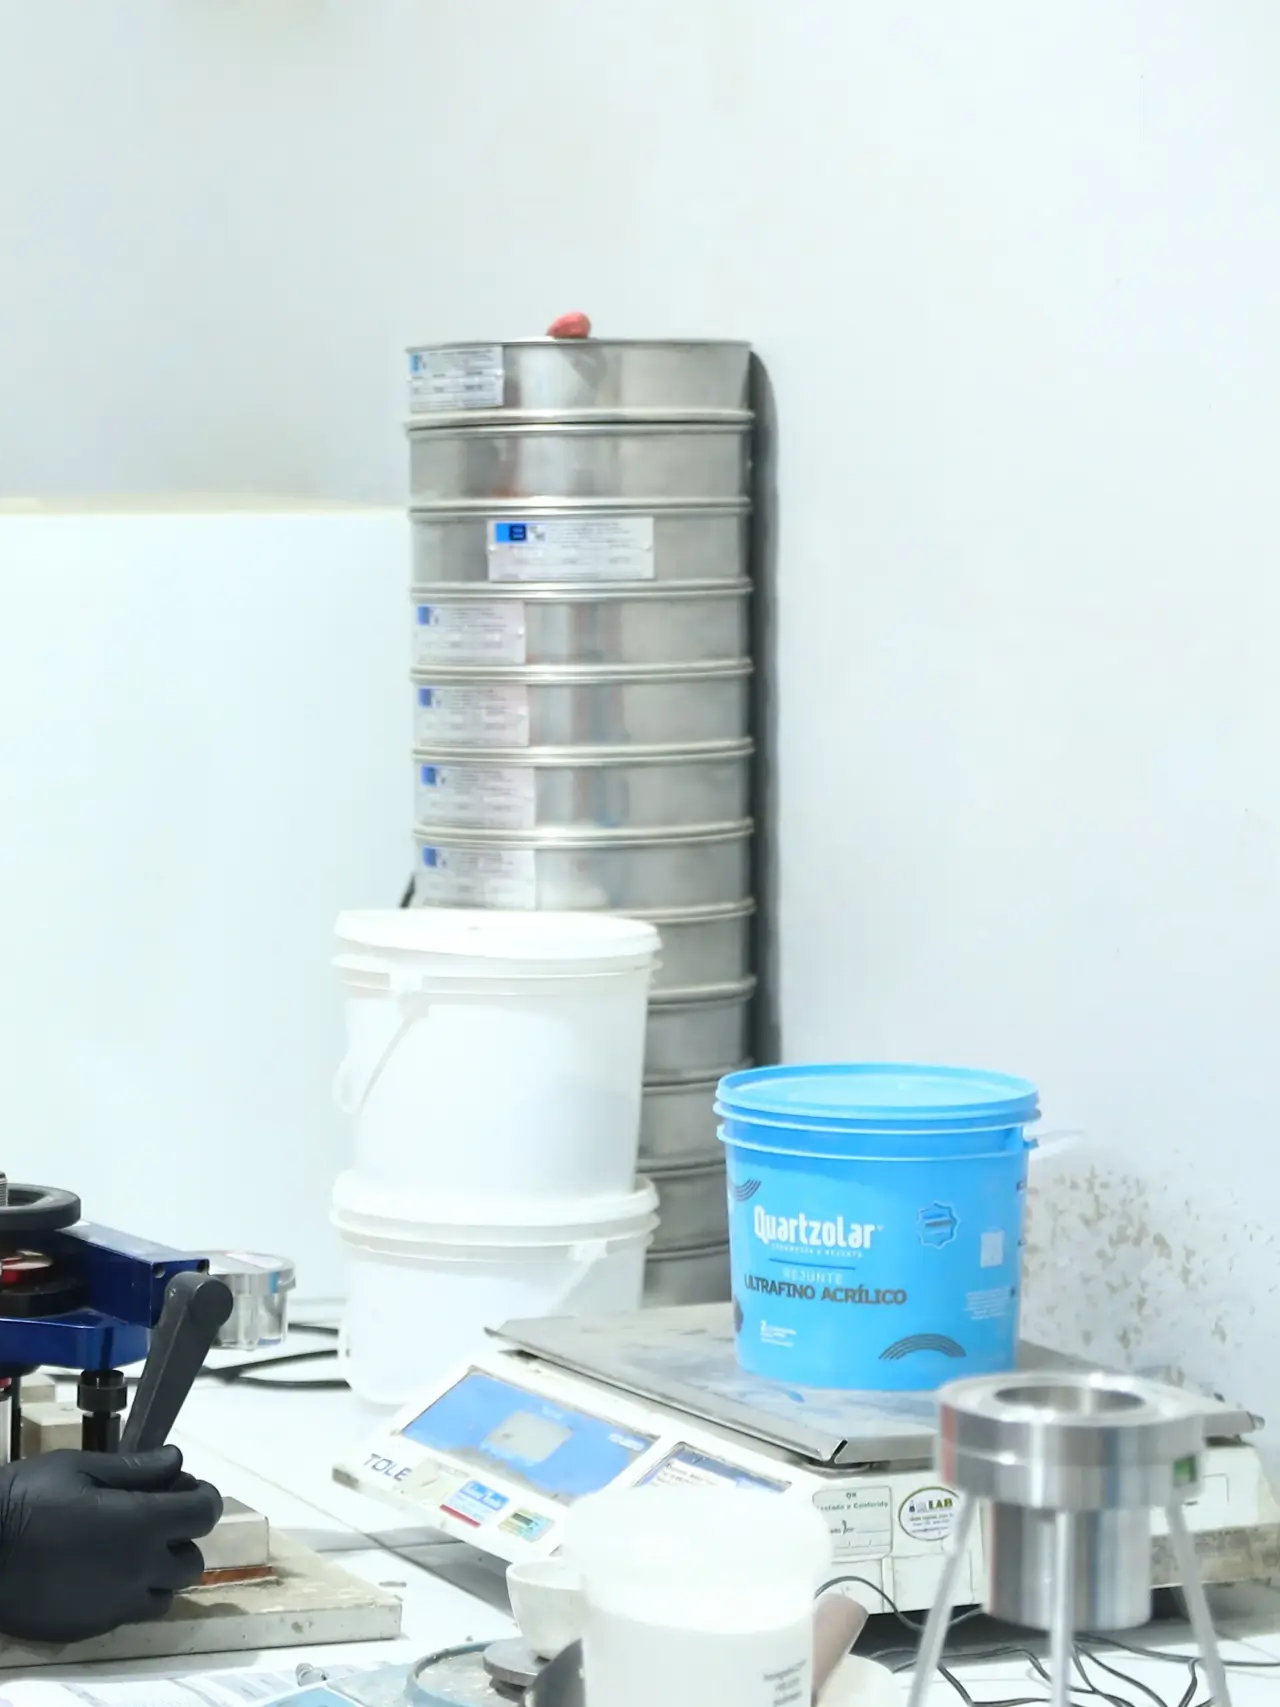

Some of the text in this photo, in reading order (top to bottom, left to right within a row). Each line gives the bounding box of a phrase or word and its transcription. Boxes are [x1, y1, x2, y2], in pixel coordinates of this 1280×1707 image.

[753, 1204, 876, 1249] Quartzolar
[744, 1273, 908, 1305] ULTRAFINO ACRÍLICO
[782, 1267, 843, 1285] REJUNTE
